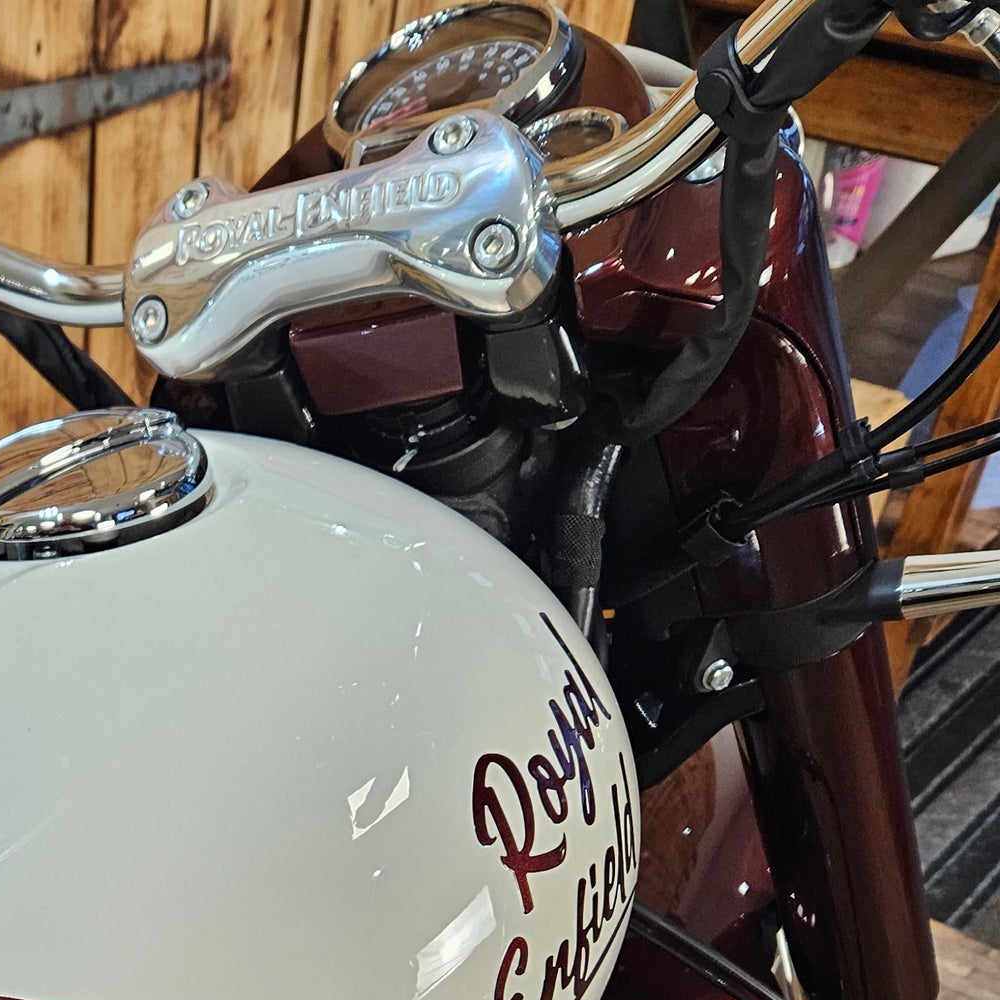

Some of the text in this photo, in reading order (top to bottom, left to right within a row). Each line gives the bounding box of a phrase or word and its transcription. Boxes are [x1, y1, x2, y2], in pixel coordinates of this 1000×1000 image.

[175, 170, 462, 266] ROYAL ENFIELD
[472, 612, 612, 915] Royal
